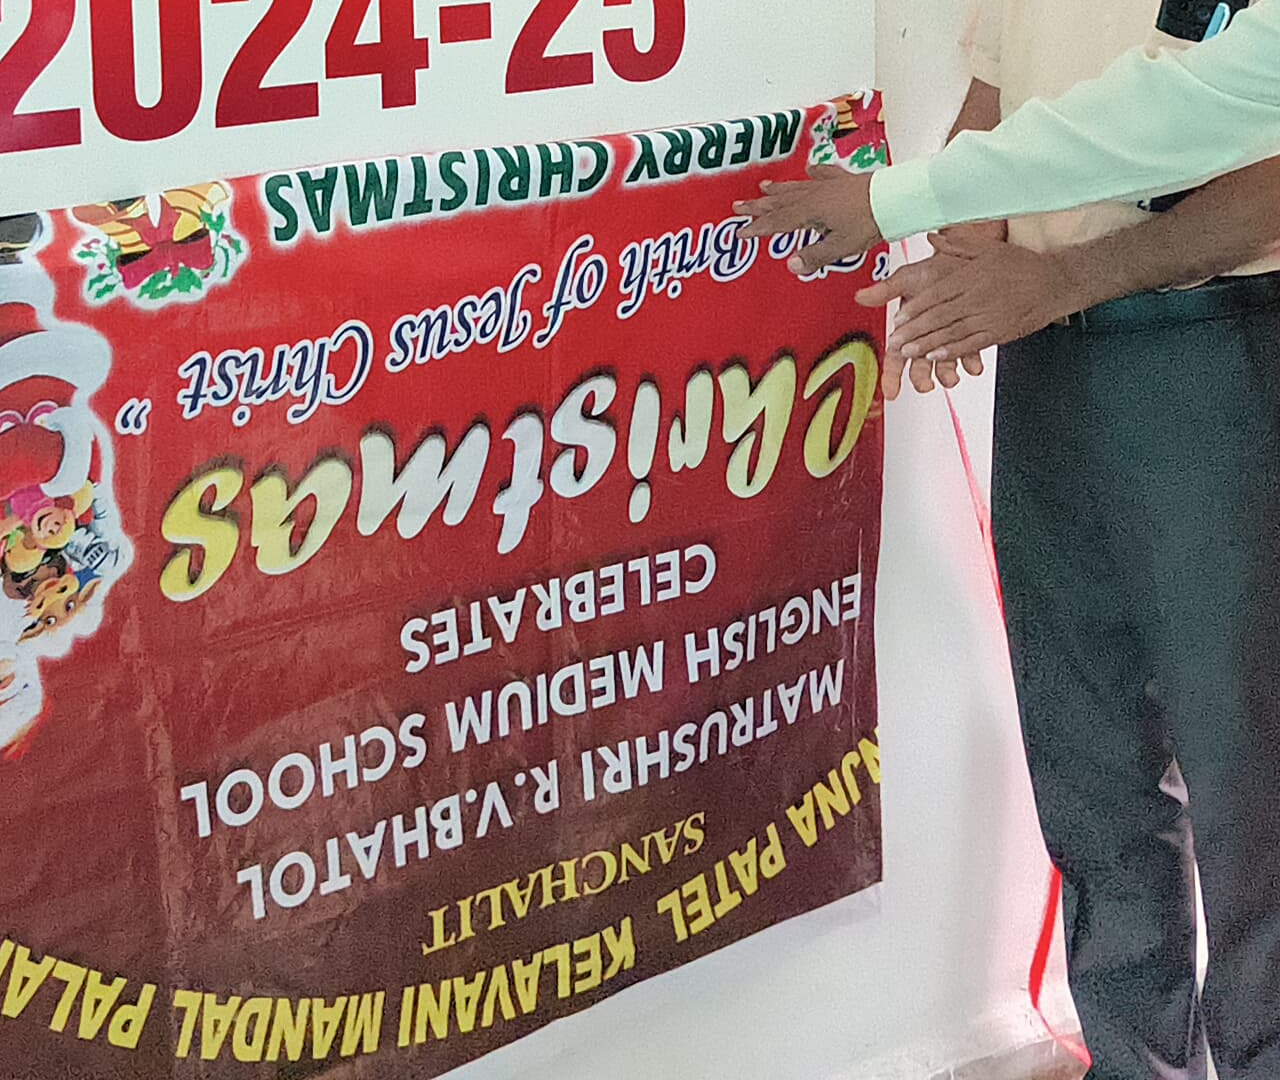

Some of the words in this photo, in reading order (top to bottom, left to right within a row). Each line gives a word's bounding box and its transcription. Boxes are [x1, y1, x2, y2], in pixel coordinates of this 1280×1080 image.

[264, 141, 609, 242] CHRISTMAS
[625, 108, 803, 184] MERRY
[386, 263, 538, 372] Jesus
[536, 234, 608, 350] of
[179, 320, 373, 426] Christ
[158, 338, 881, 602] Christmas
[400, 543, 717, 673] CELEBRATES
[685, 572, 863, 683] ENGLISH
[445, 641, 665, 752] MEDIUM
[581, 658, 846, 801] MATRUSHRI
[180, 713, 427, 838] SCHOOL
[421, 812, 707, 956] SANCHALIT
[656, 821, 788, 943] PATEL
[173, 988, 386, 1062] MANDAL
[398, 917, 637, 1048] KELAVANI
